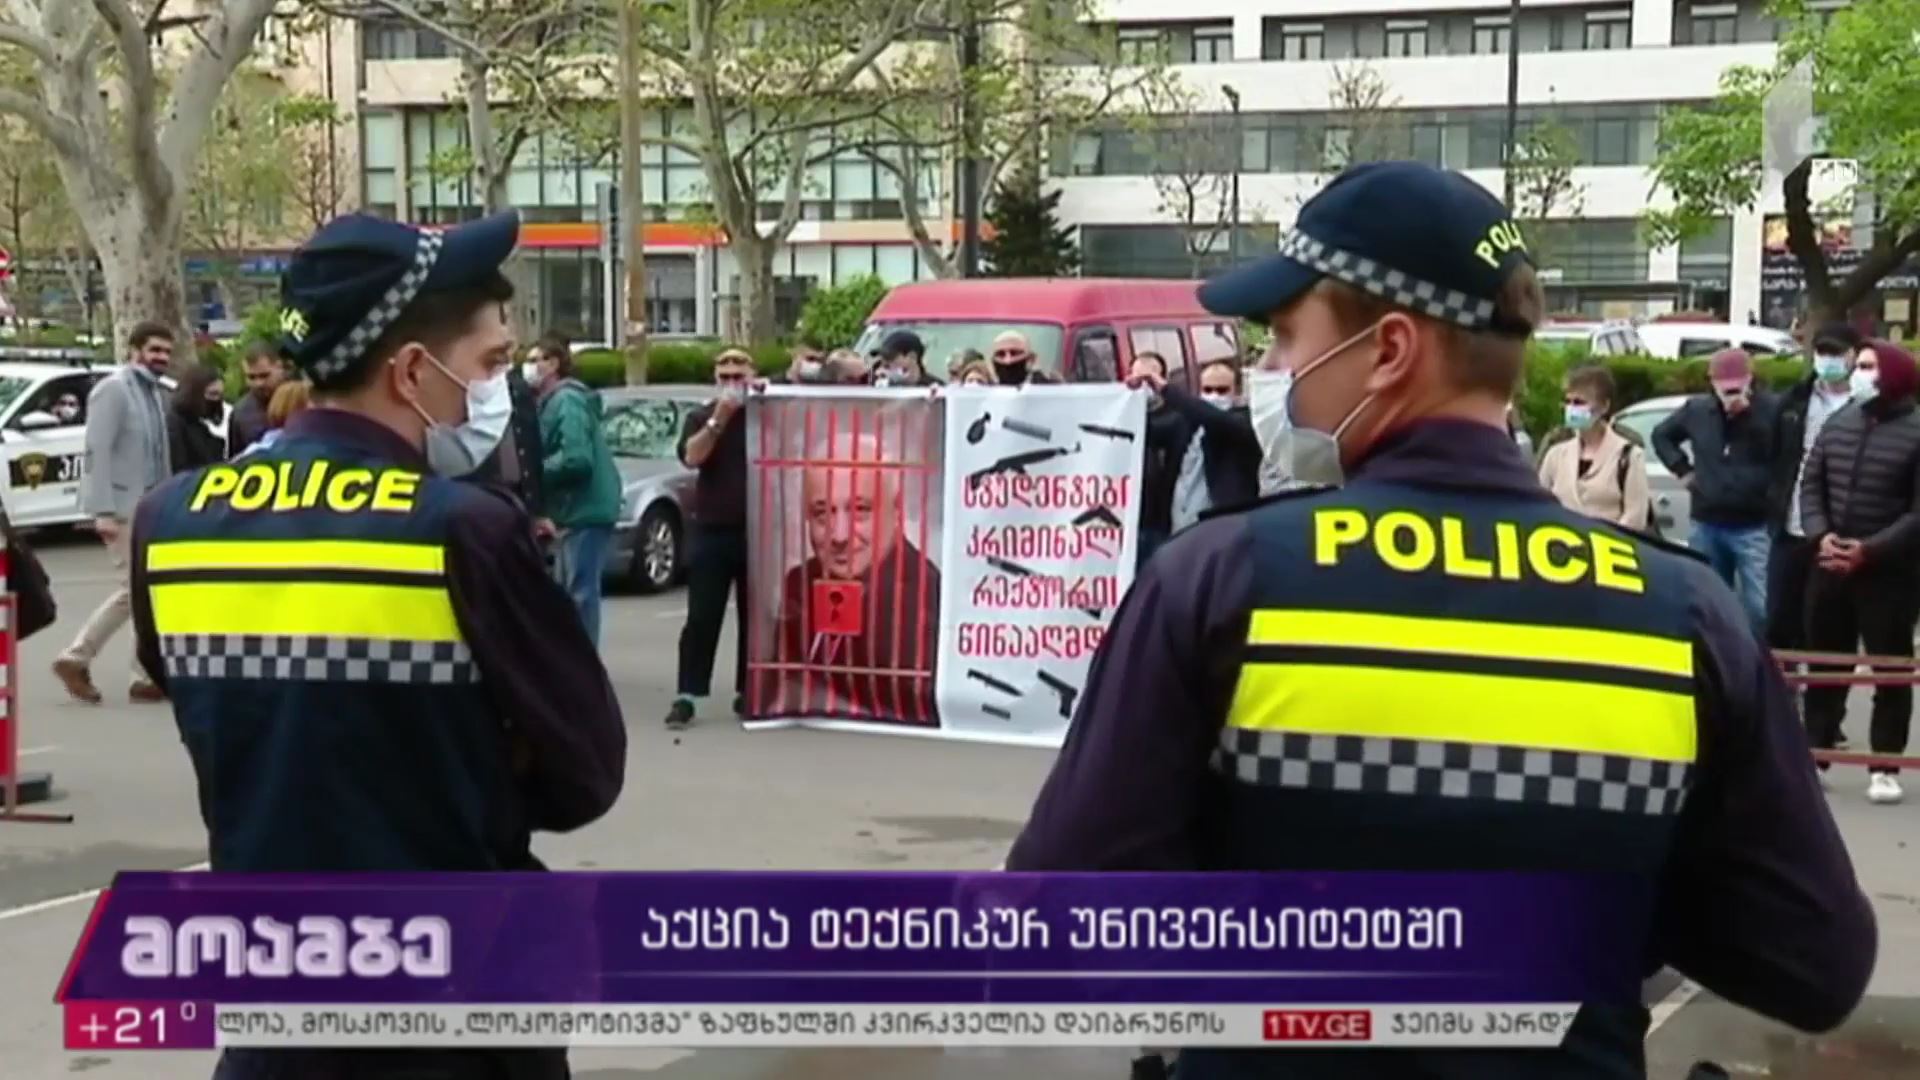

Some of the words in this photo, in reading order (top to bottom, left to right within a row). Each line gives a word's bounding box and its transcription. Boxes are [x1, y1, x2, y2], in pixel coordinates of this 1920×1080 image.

[1474, 221, 1527, 268] POLI
[190, 461, 421, 513] POLICE
[1315, 510, 1645, 593] POLICE
[958, 622, 1106, 658] წინააღმდ
